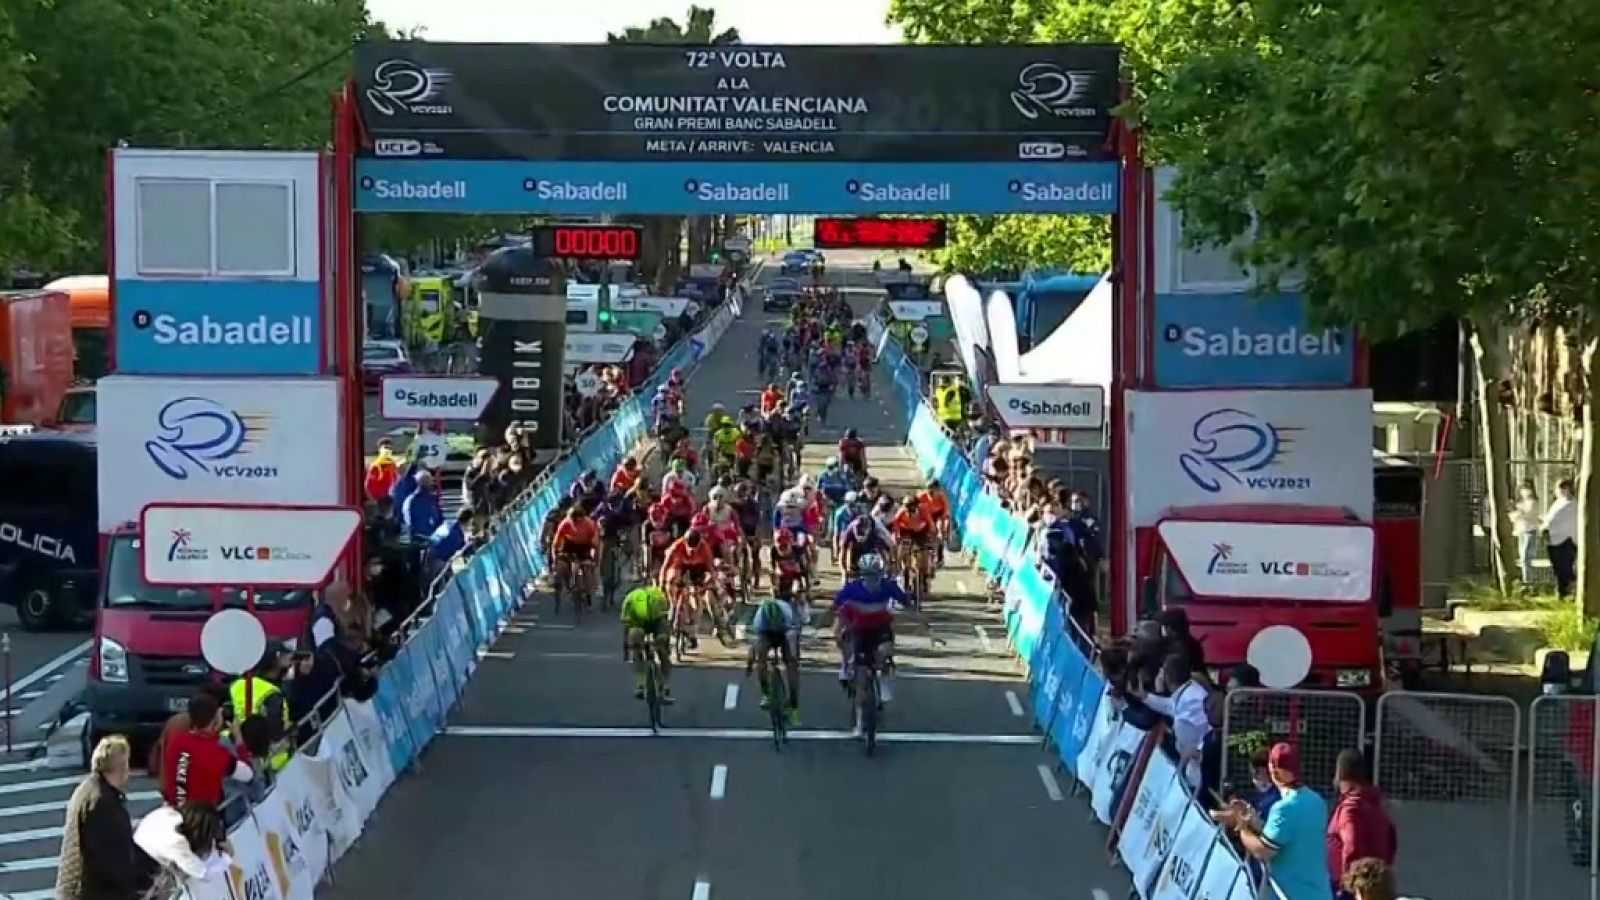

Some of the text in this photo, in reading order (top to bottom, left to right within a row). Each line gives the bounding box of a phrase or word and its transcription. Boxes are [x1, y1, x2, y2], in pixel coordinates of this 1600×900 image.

[720, 52, 786, 69] VOLTA
[717, 78, 750, 90] A LA
[603, 96, 868, 114] COMUNITAT VALENCIANA
[634, 118, 837, 131] GRAN PREMI BANC SABADELL
[646, 140, 687, 152] META
[763, 141, 835, 154] VALENCIA
[1022, 146, 1047, 156] UCI
[375, 180, 466, 198] Sabadell
[538, 180, 627, 200] Sabadell
[698, 182, 789, 201] Sabadell
[861, 183, 951, 201] Sabadell
[1022, 183, 1112, 201] Sabadell
[153, 314, 312, 345] Sabadell
[510, 340, 542, 432] GOBIK
[407, 391, 478, 407] Sabadell
[1022, 400, 1091, 416] Sabadell
[214, 466, 279, 478] VCV2021
[1246, 477, 1311, 490] VCV2021
[0, 522, 76, 565] OLICÍA
[220, 546, 255, 560] VLC
[1260, 561, 1294, 576] VLC
